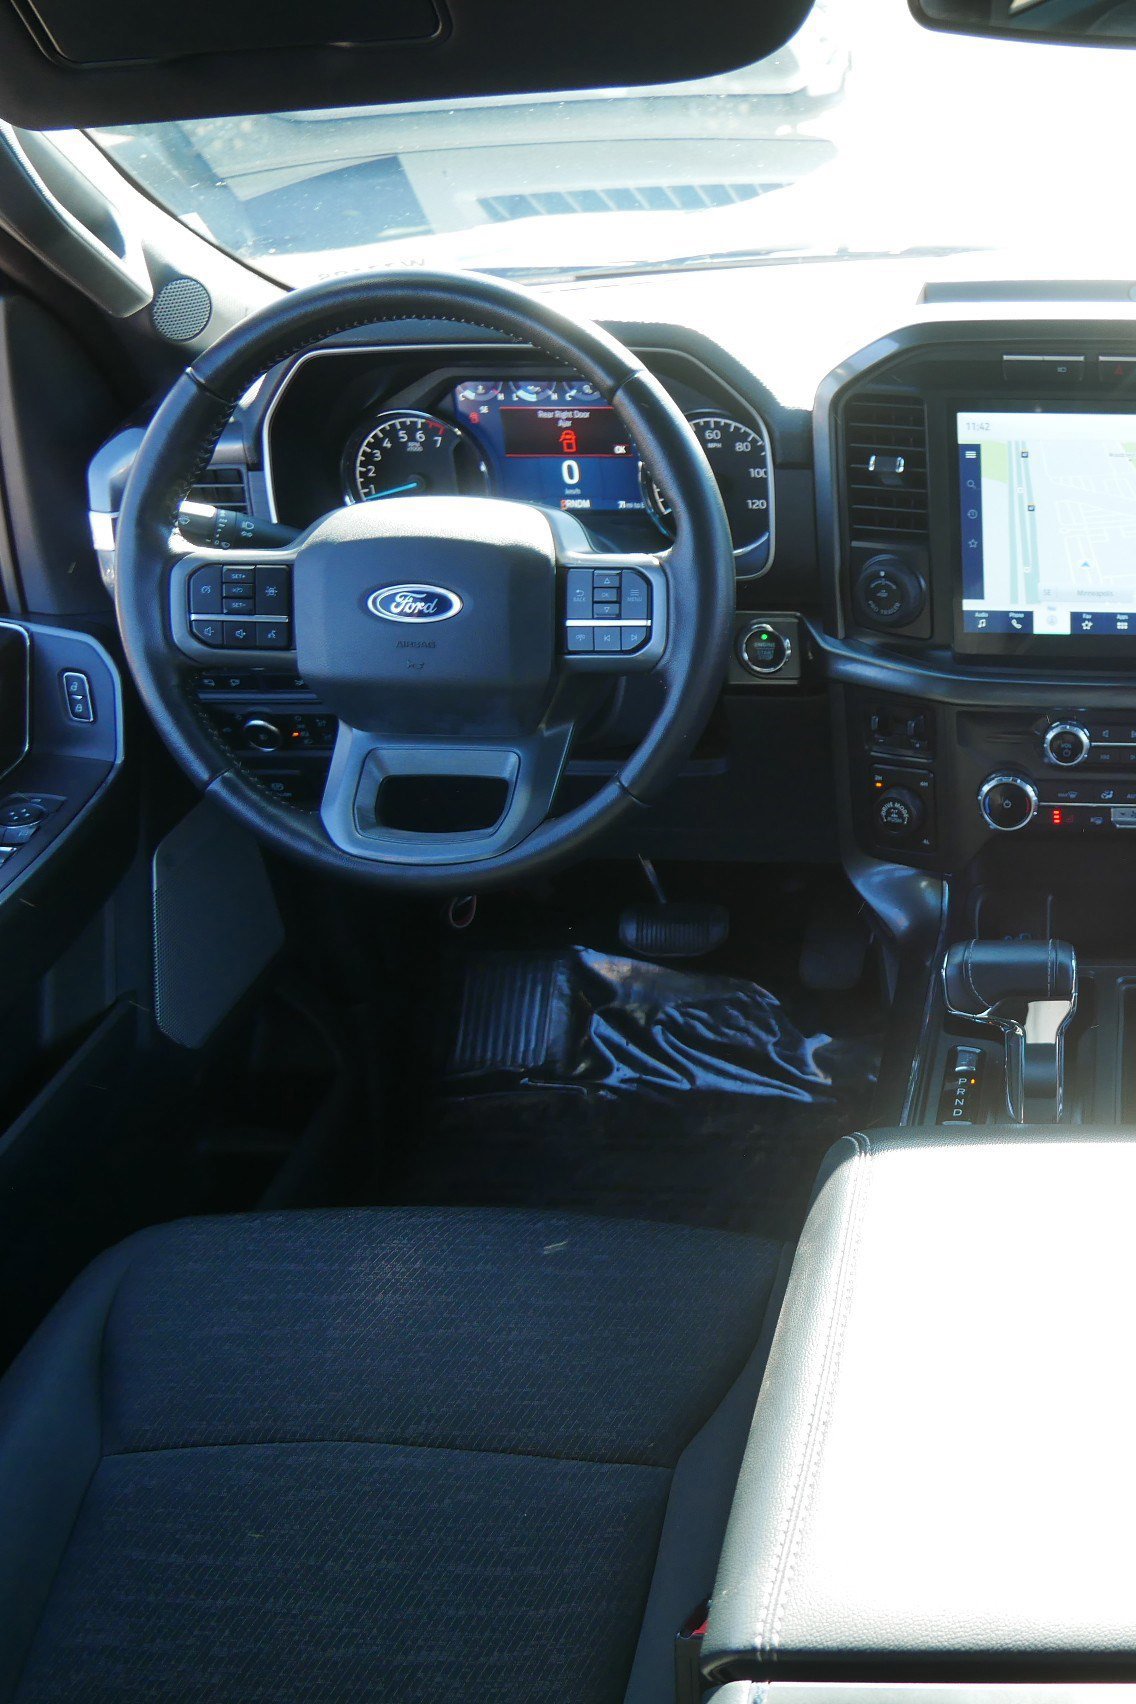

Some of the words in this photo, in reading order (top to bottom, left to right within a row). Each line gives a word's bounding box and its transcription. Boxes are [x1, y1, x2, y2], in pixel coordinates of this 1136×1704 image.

[537, 410, 553, 419] Rear
[554, 410, 573, 420] Right
[573, 410, 590, 419] Door
[557, 419, 572, 428] Ajar
[966, 422, 990, 431] 11:42
[398, 430, 408, 442] 5
[415, 430, 425, 442] 6
[704, 430, 721, 440] 60
[382, 437, 392, 449] 4
[434, 436, 443, 448] 7
[735, 442, 751, 452] 80
[614, 444, 626, 454] OK
[373, 450, 382, 461] 3
[367, 466, 376, 477] 2
[561, 460, 580, 485] 0
[369, 485, 376, 495] 1
[747, 500, 767, 509] 120
[1077, 589, 1113, 598] Minneapolis
[390, 592, 438, 614] Ford
